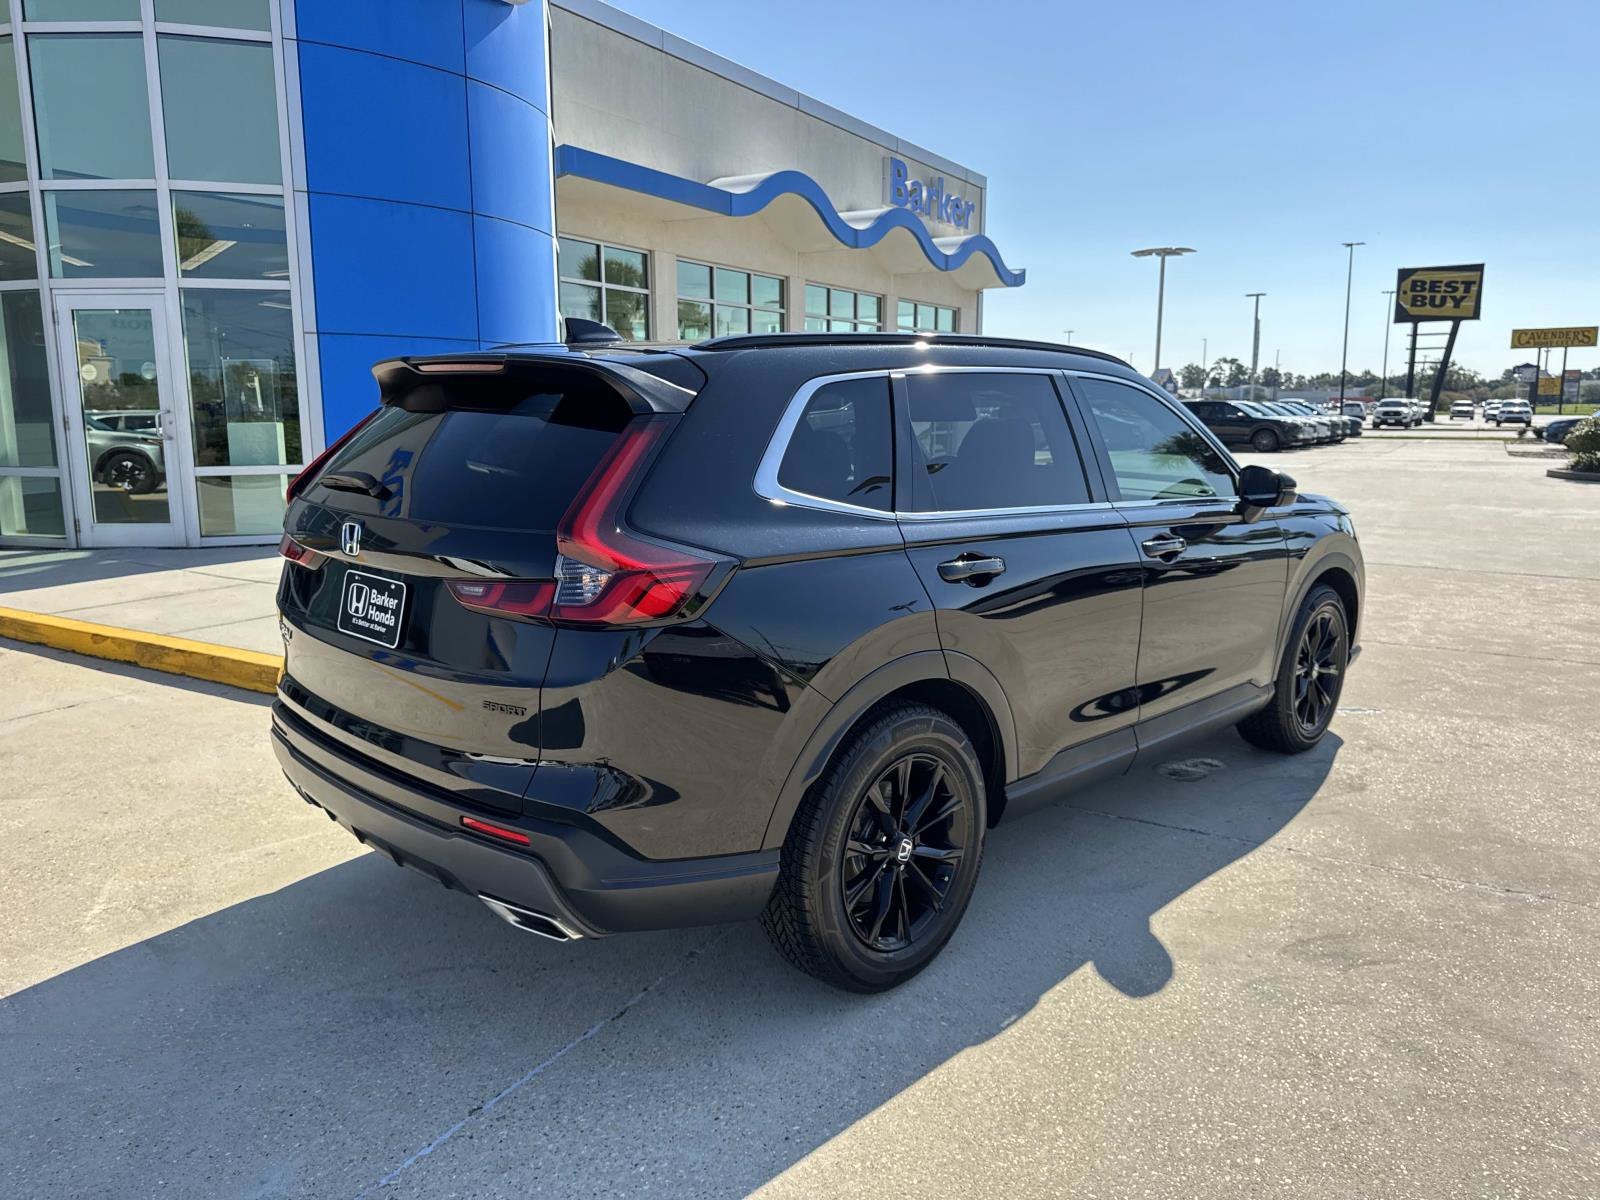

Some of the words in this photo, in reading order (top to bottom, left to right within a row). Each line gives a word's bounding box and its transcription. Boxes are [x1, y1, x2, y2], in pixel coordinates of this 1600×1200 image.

[890, 156, 976, 229] Barker
[1410, 280, 1477, 294] BEST
[1410, 294, 1468, 308] BUY
[370, 589, 398, 610] Barker
[367, 604, 395, 627] Honda
[482, 700, 527, 716] SPORT
